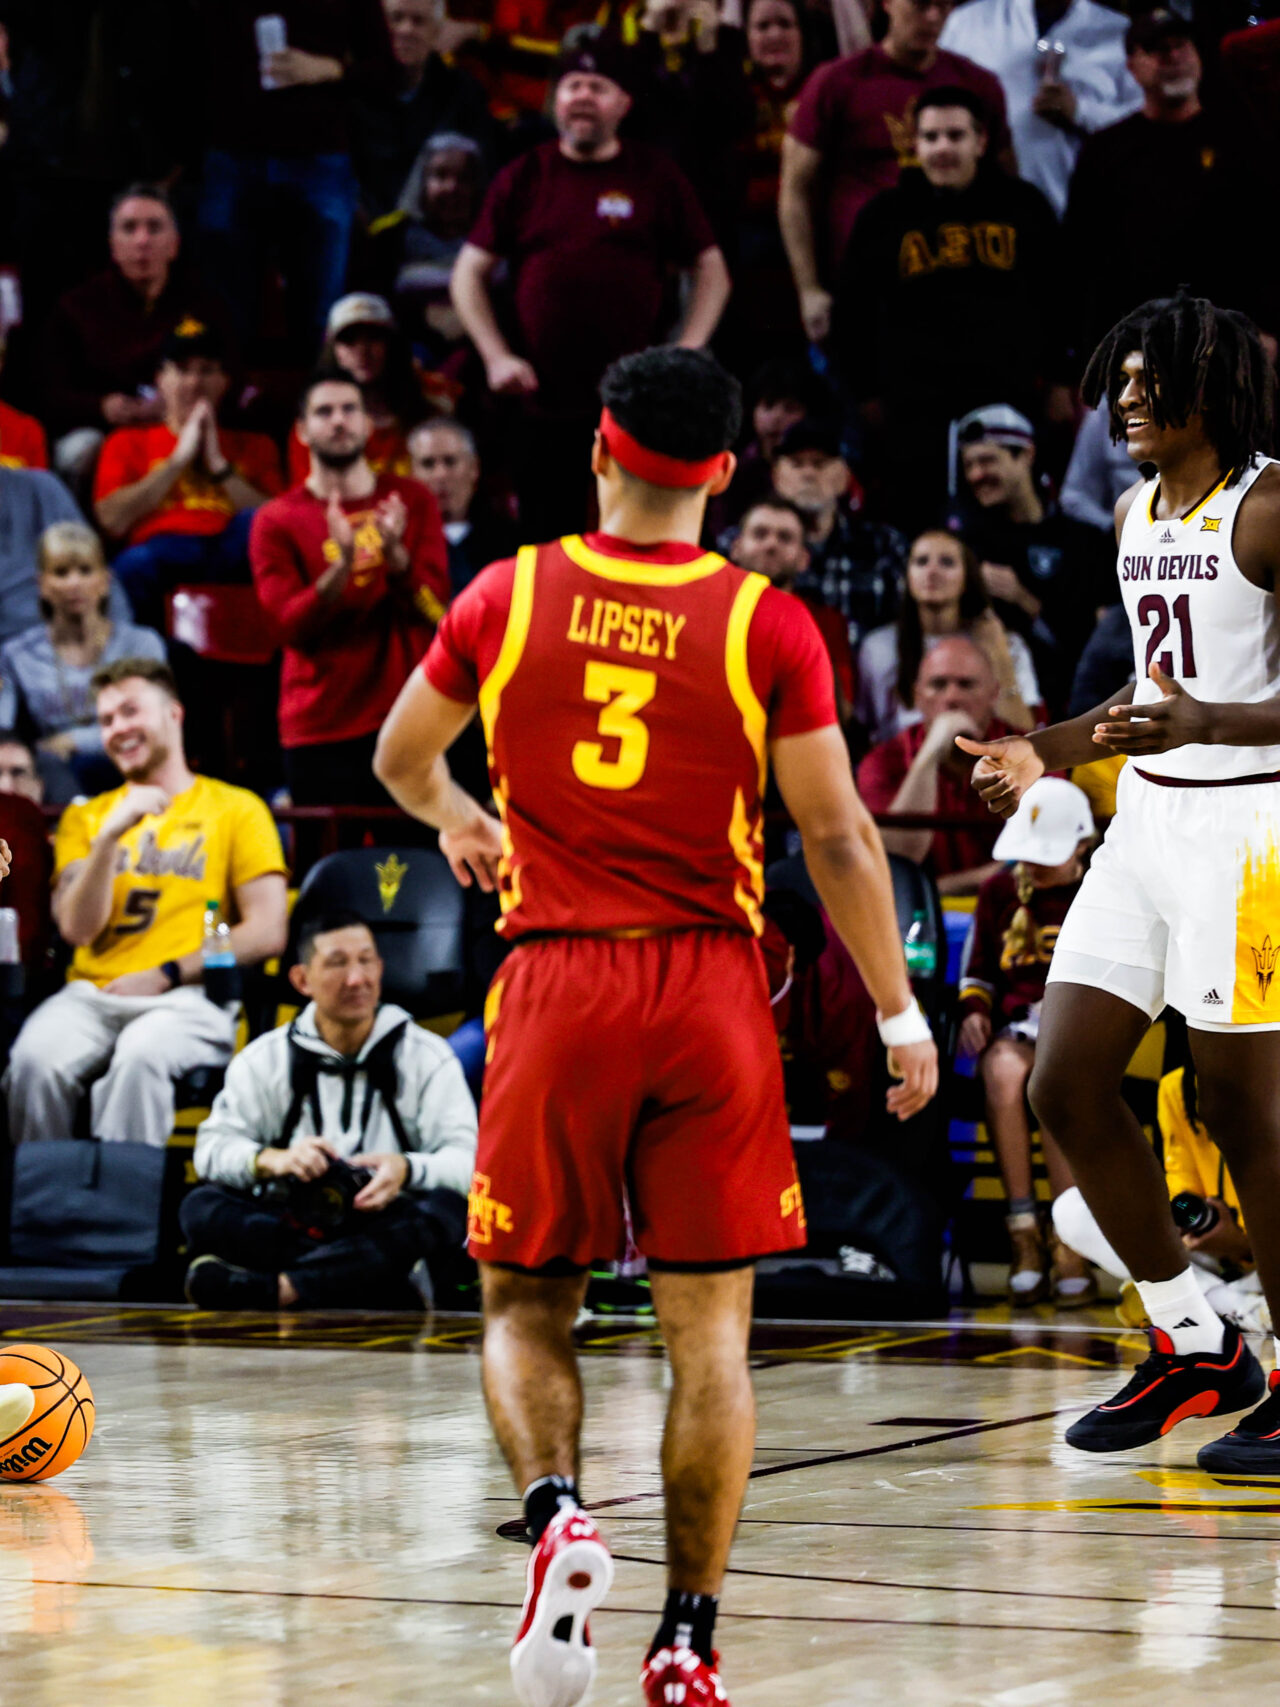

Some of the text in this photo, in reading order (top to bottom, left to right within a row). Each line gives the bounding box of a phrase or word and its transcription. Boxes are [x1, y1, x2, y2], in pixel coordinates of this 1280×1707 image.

[899, 221, 1017, 277] ASU
[1122, 554, 1221, 582] SUN DEVILS
[567, 595, 687, 661] LIPSEY
[1137, 593, 1198, 679] 21
[571, 660, 658, 791] 3
[114, 889, 162, 935] 5
